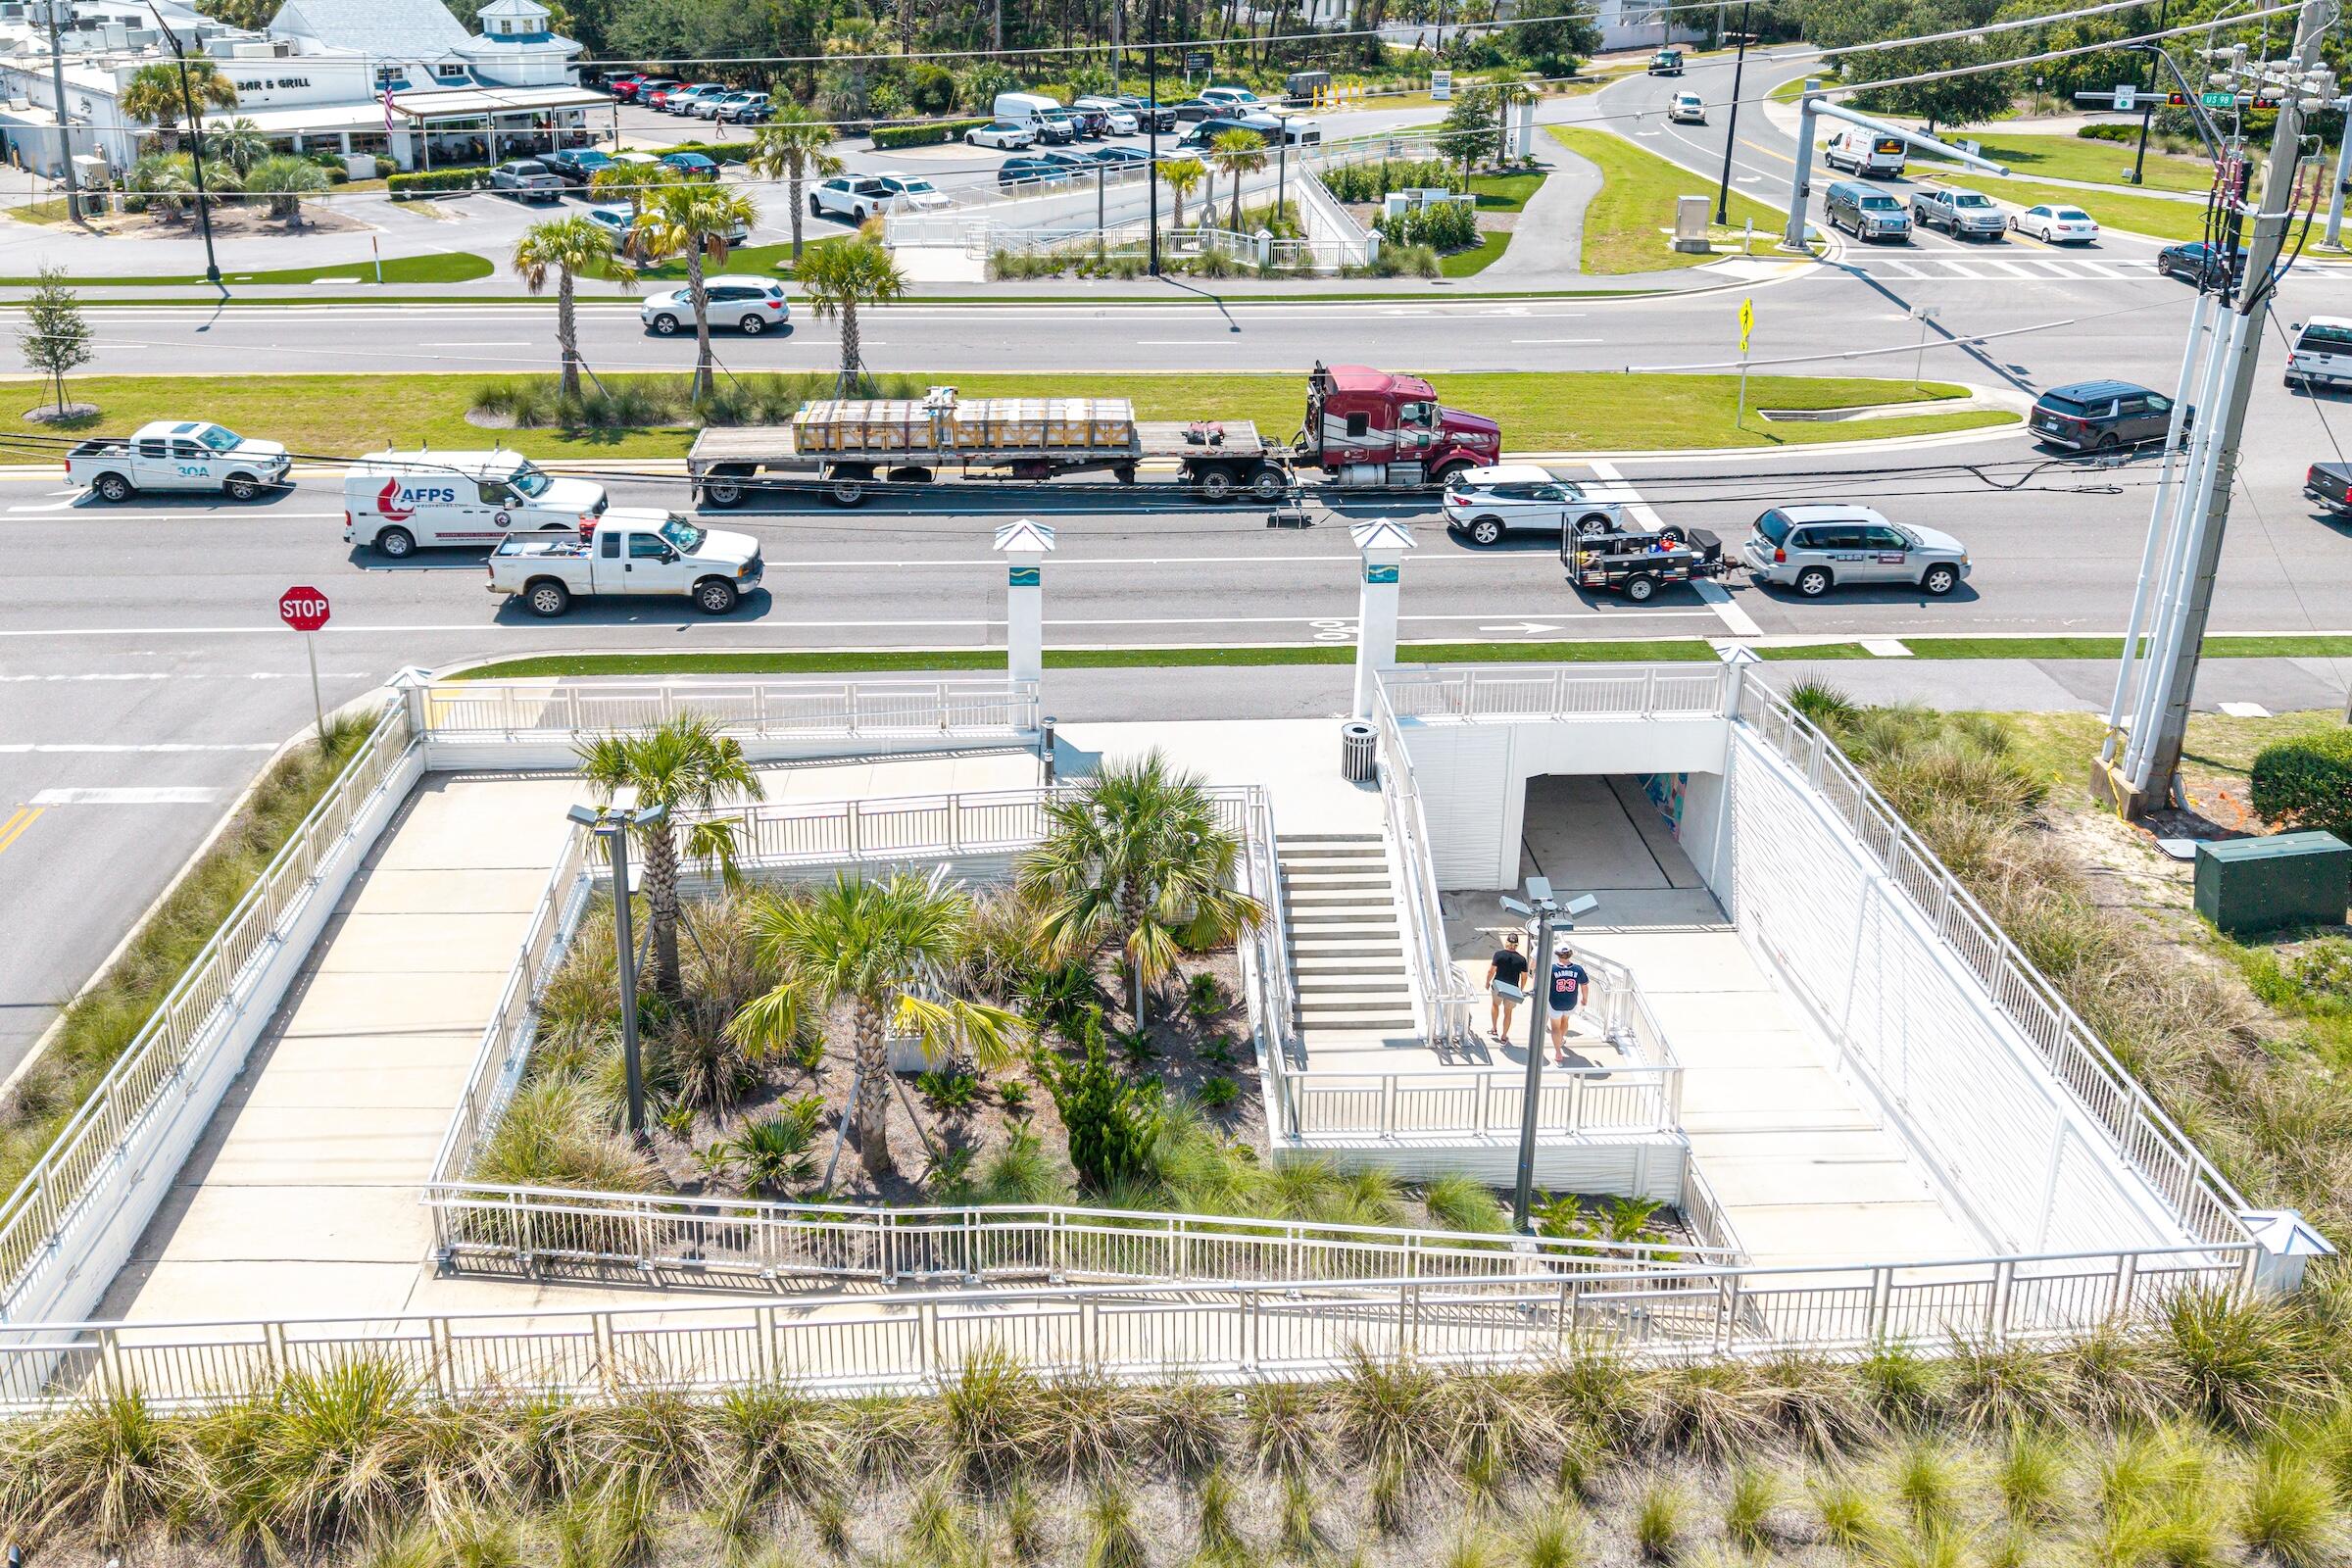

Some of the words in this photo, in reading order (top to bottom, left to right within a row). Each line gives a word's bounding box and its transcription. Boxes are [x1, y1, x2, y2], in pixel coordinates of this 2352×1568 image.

[237, 80, 263, 91] BAR
[266, 80, 274, 89] &
[277, 77, 311, 89] GRILL
[2206, 95, 2218, 104] US
[2220, 95, 2230, 104] 98
[400, 488, 455, 503] AFPS
[282, 600, 327, 618] STOP
[1555, 978, 1577, 993] 23
